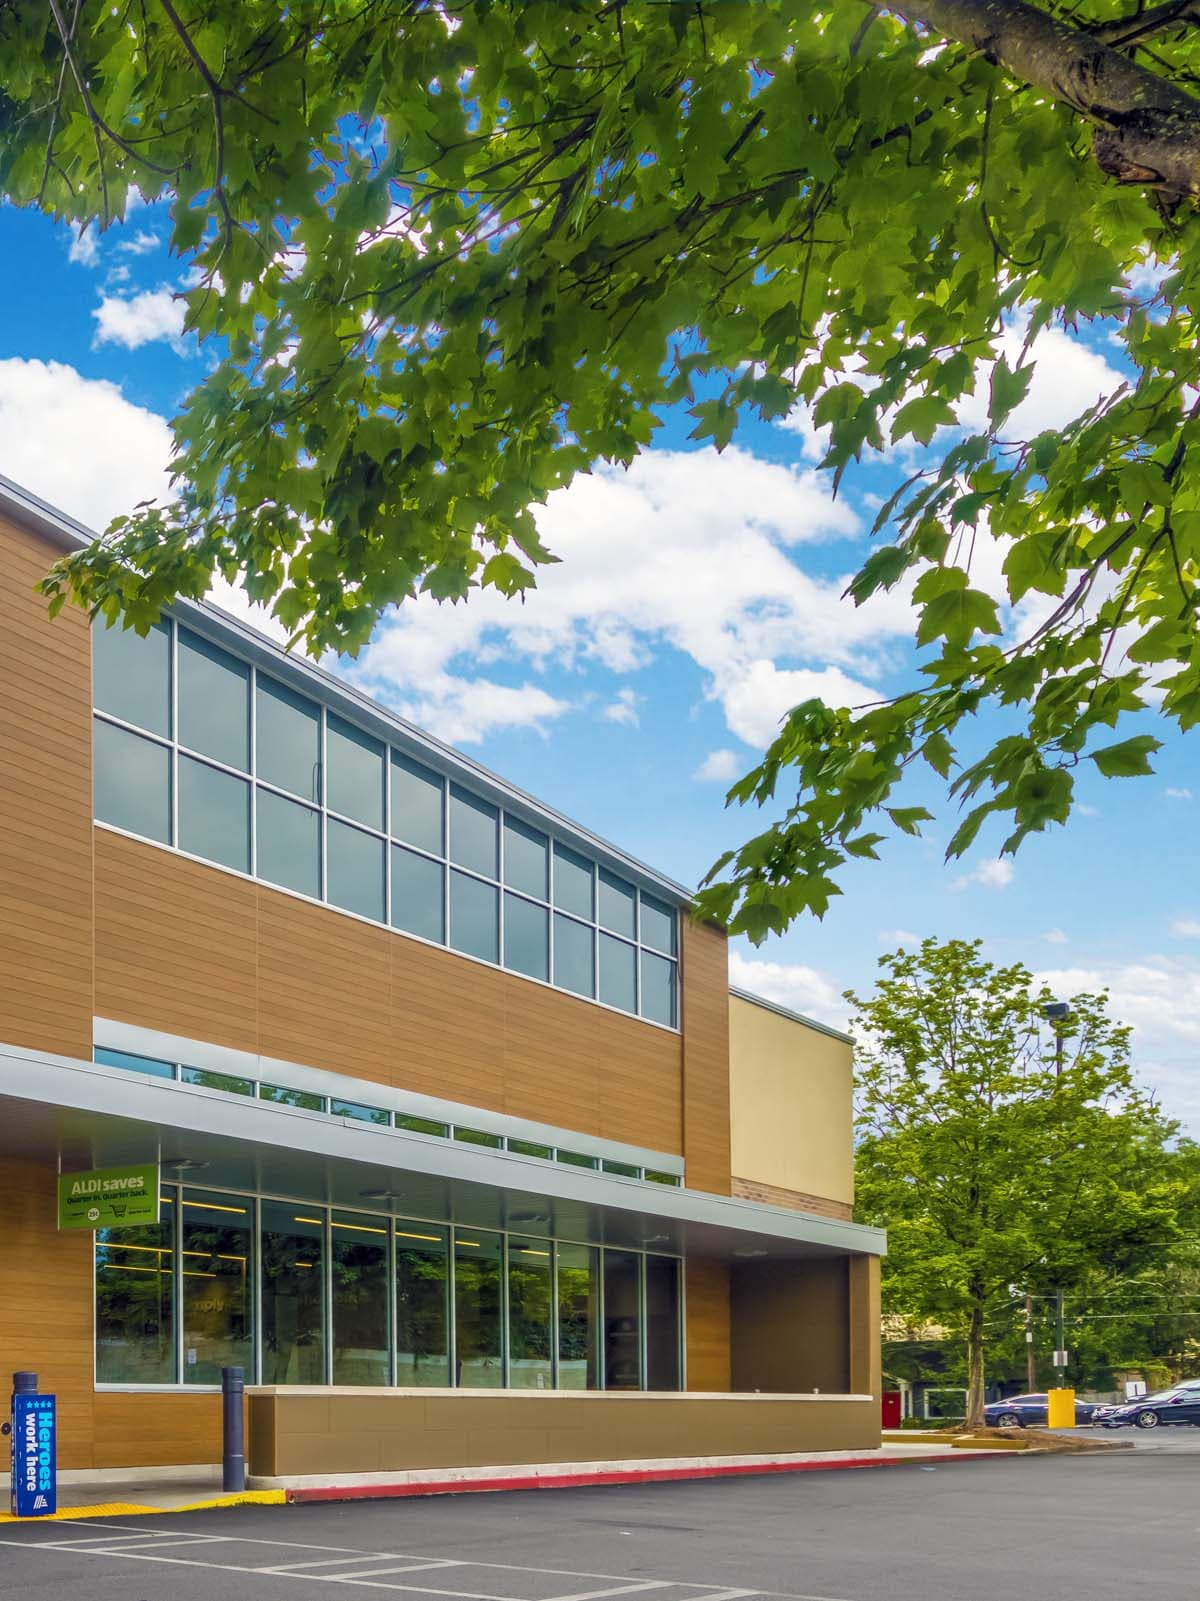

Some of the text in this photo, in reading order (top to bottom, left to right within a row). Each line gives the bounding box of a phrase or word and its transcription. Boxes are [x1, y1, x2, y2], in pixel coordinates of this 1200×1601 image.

[71, 1175, 144, 1195] ALDI saves
[26, 1412, 39, 1492] work here
[38, 1411, 53, 1491] Heroes
